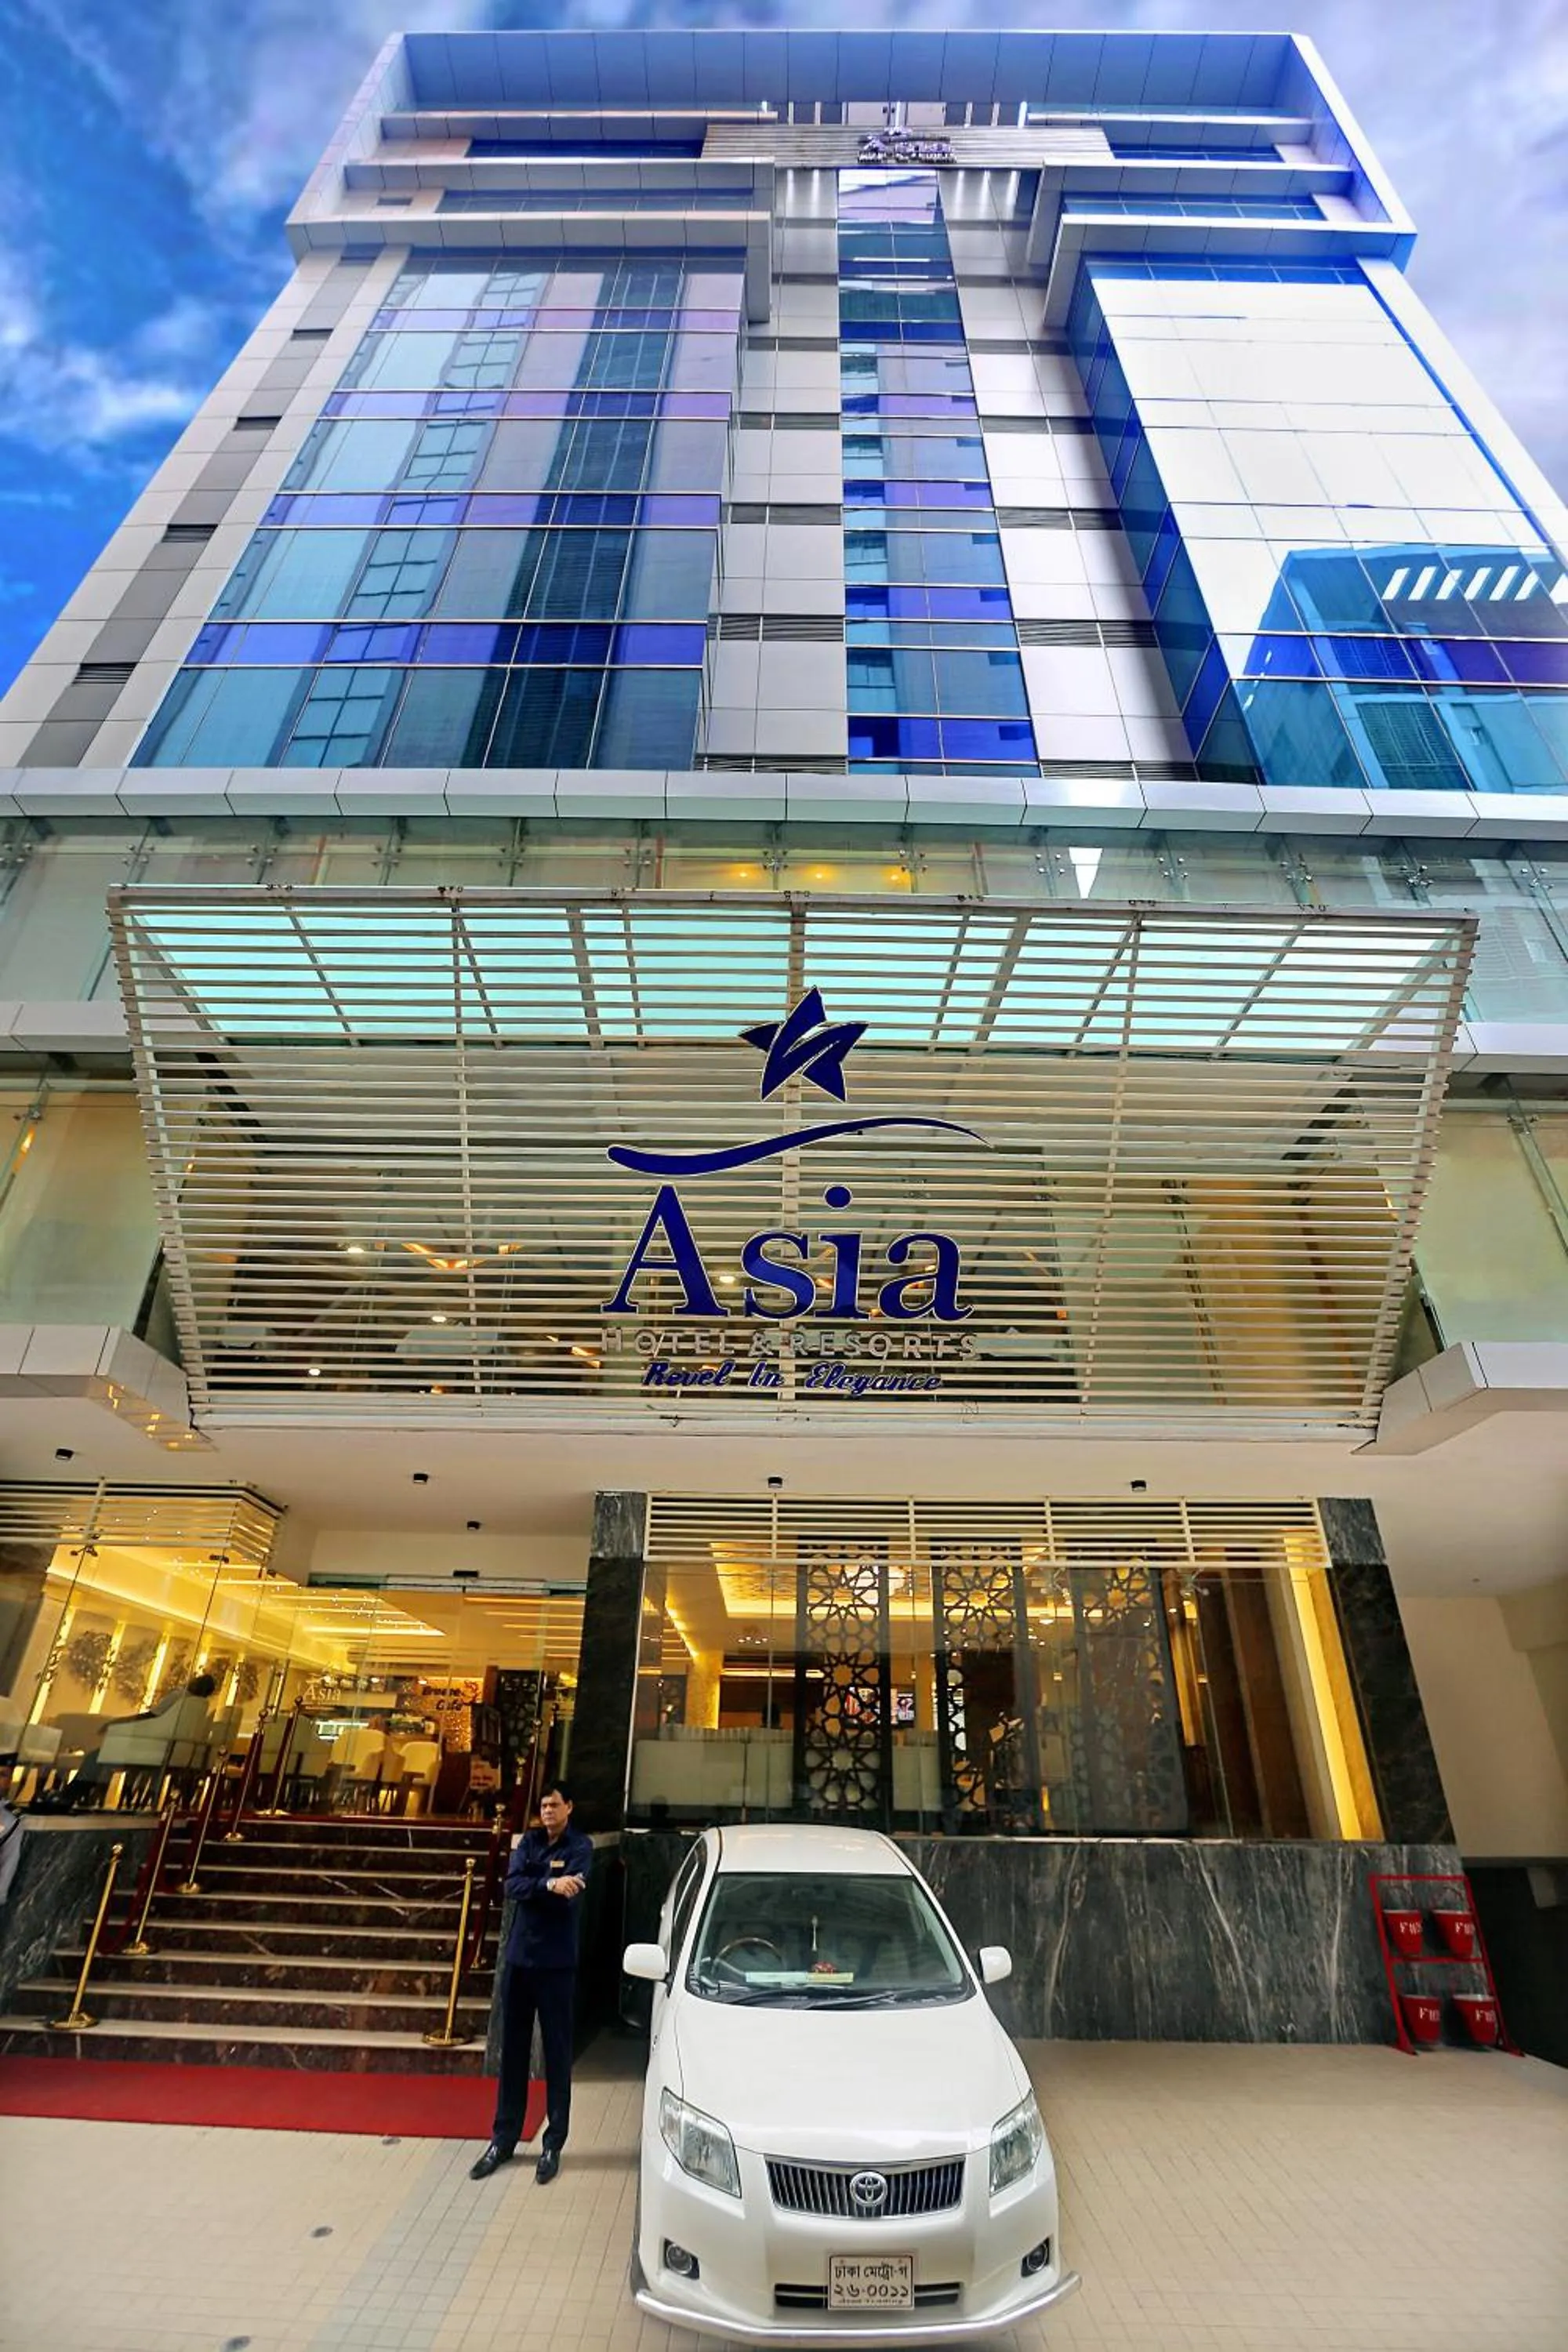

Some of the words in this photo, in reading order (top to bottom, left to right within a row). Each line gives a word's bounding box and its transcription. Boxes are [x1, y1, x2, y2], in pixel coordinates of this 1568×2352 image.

[601, 1184, 975, 1321] Asia
[601, 1327, 735, 1356] HOTEL
[789, 1330, 978, 1359] RESORTS
[641, 1359, 736, 1387] Revel
[804, 1361, 943, 1397] Elegance
[835, 2265, 860, 2278] ঢাকা
